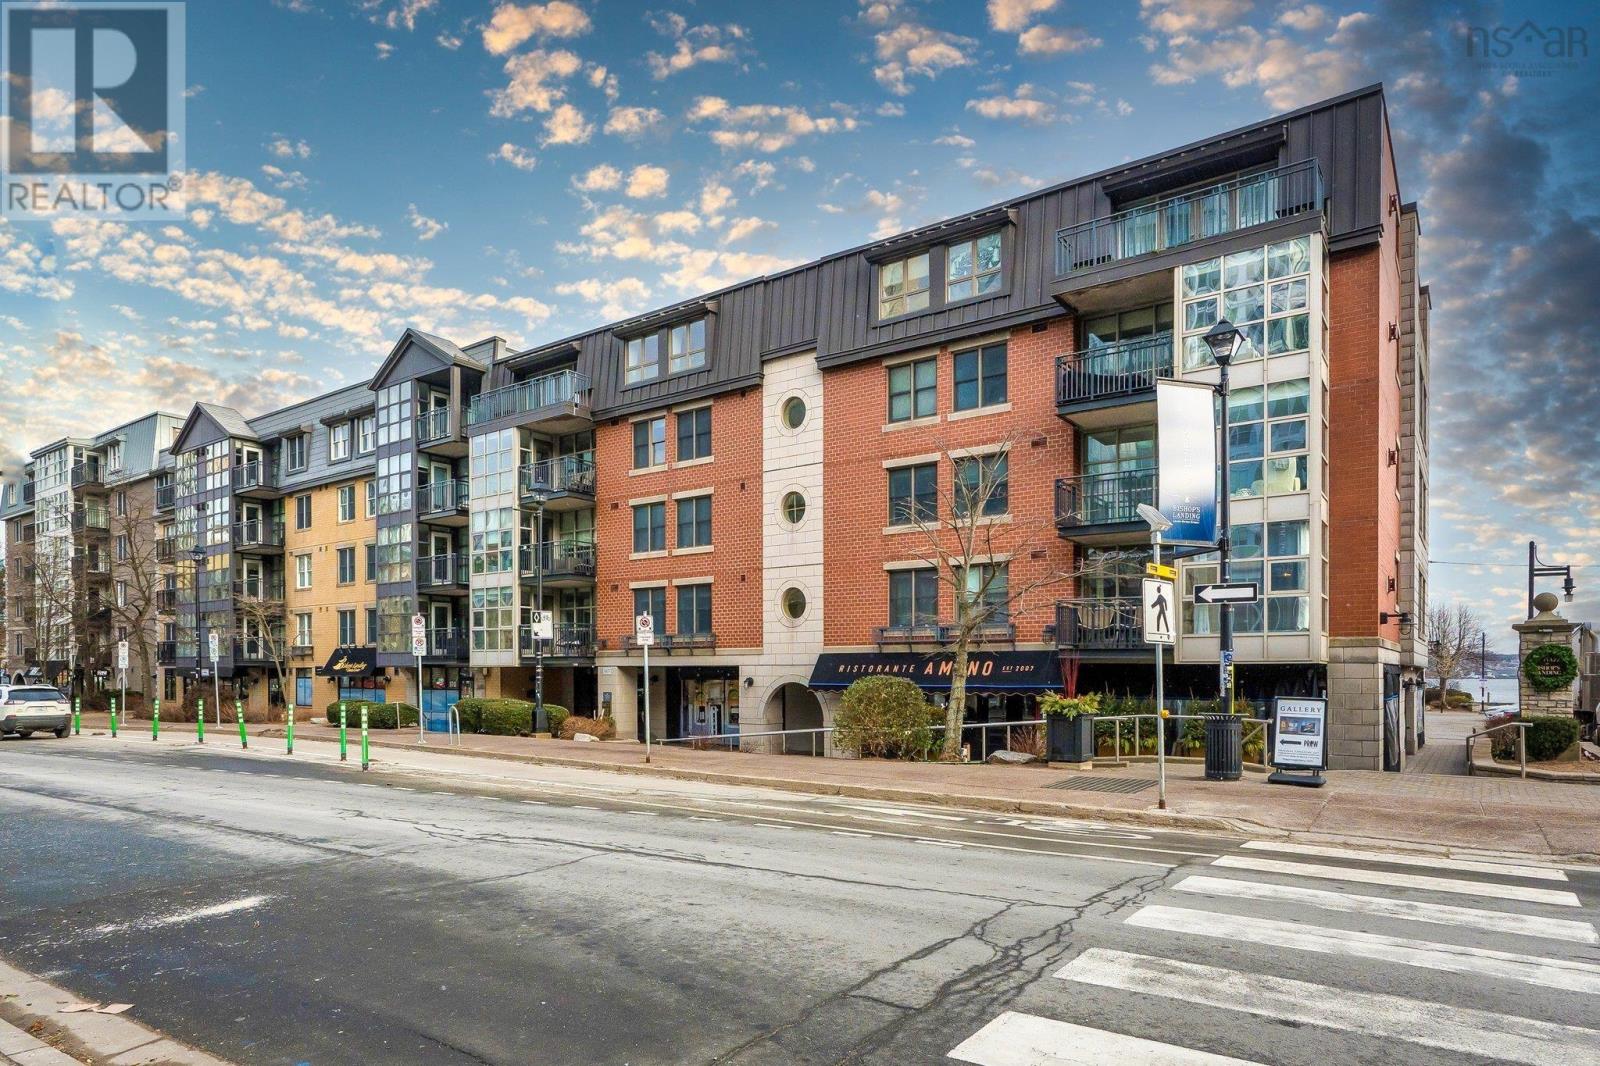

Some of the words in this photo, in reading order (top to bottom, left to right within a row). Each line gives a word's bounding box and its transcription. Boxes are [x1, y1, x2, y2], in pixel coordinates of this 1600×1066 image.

[1173, 512, 1200, 520] LANDING
[838, 664, 916, 673] RISTORANTE
[924, 660, 994, 676] AMNO
[1280, 705, 1321, 713] GALLERY
